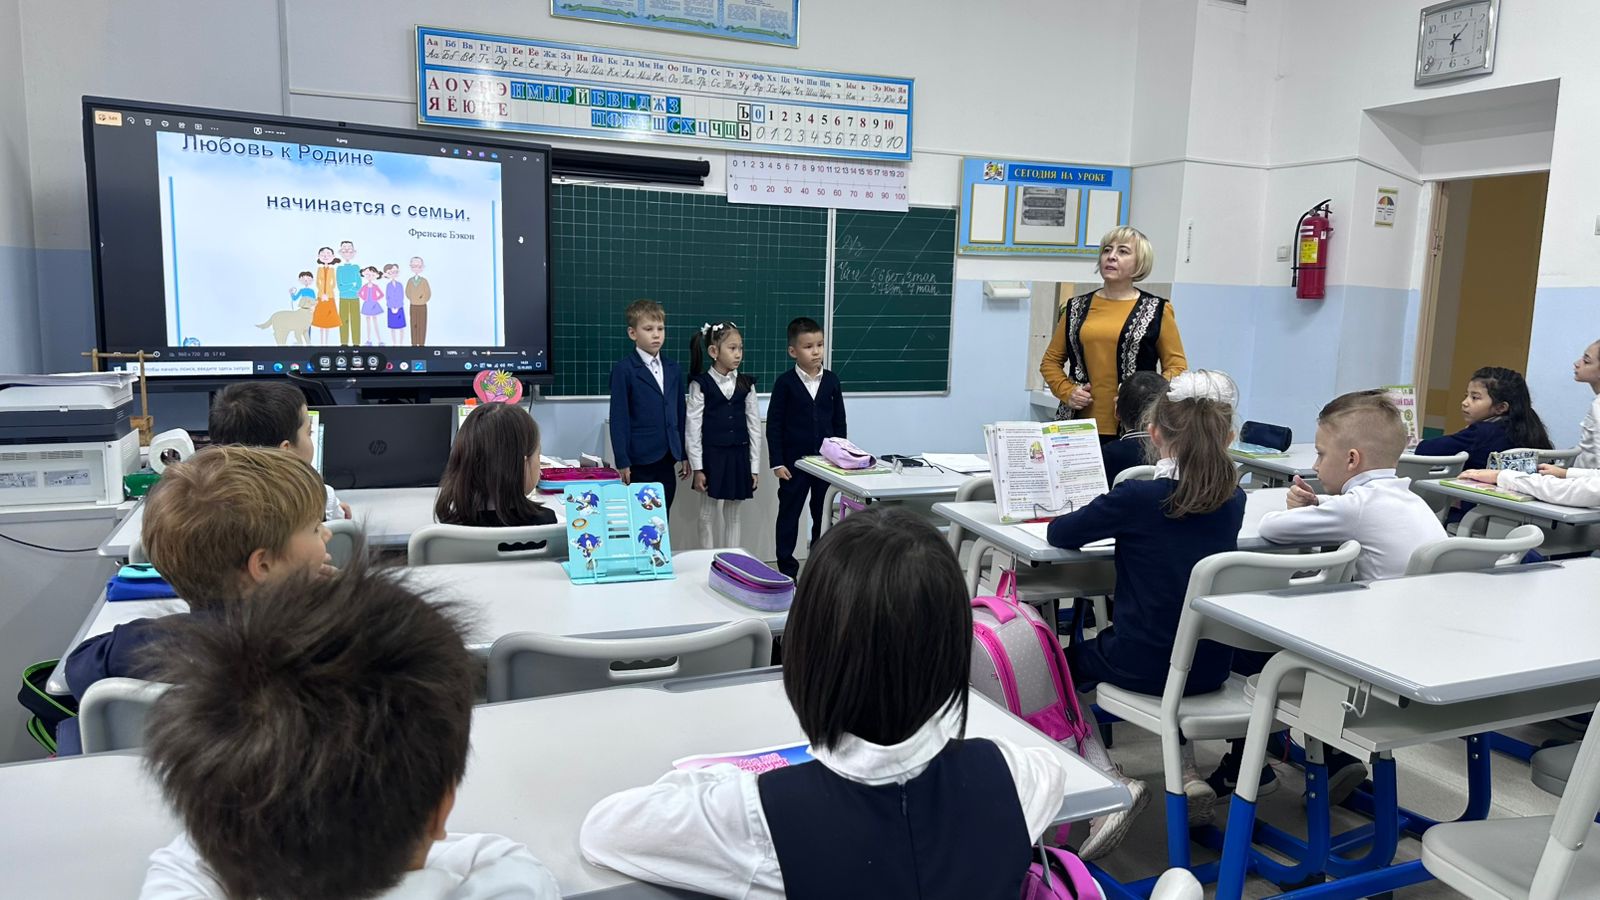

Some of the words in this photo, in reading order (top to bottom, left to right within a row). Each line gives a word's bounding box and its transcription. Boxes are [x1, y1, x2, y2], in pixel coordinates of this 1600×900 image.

[428, 77, 440, 90] А
[446, 78, 457, 92] О
[463, 79, 474, 93] У
[497, 82, 508, 96] Э
[512, 83, 525, 98] Н
[527, 84, 542, 100] М
[545, 86, 557, 102] Л
[561, 87, 572, 103] Р
[578, 88, 588, 104] Й
[592, 90, 605, 106] Б
[607, 92, 620, 107] В
[623, 93, 635, 108] Г
[637, 95, 649, 111] Д
[653, 97, 665, 111] Ж
[668, 98, 679, 113] З
[740, 106, 749, 118] Ъ
[428, 97, 440, 111] Я
[447, 96, 458, 112] Ё
[463, 99, 476, 114] Ю
[499, 102, 508, 116] Е
[653, 117, 665, 131] Ш
[667, 118, 680, 133] С
[682, 119, 695, 134] Х
[698, 121, 708, 134] Ц
[712, 122, 721, 135] Ч
[741, 125, 749, 136] Ь
[755, 109, 762, 119] 0
[769, 110, 774, 120] 1
[782, 111, 788, 121] 2
[795, 112, 801, 122] 3
[808, 113, 814, 123] 4
[821, 114, 828, 125] 5
[834, 116, 841, 126] 6
[848, 117, 853, 127] 7
[860, 118, 866, 128] 8
[873, 118, 879, 129] 9
[884, 119, 894, 130] 10
[756, 126, 765, 139] 0
[770, 127, 778, 140] 1
[784, 128, 792, 141] 2
[797, 129, 805, 142] 3
[811, 130, 818, 143] 4
[823, 131, 832, 144] 5
[836, 132, 843, 145] 6
[849, 133, 857, 146] 7
[861, 134, 869, 147] 8
[874, 135, 882, 148] 9
[886, 135, 903, 149] 10
[182, 135, 274, 157] Любовь
[281, 146, 291, 158] к
[299, 144, 373, 165] Родине
[759, 161, 764, 169] 3
[1014, 168, 1057, 179] СЕГОДНЯ
[1061, 171, 1073, 180] НА
[1077, 172, 1106, 182] УРОКЕ
[817, 188, 825, 196] 50
[850, 190, 858, 198] 70
[267, 195, 385, 214] начинается
[391, 203, 401, 215] с
[407, 205, 471, 220] семьи.
[408, 228, 447, 240] Френсис
[449, 229, 475, 240] Бэкон
